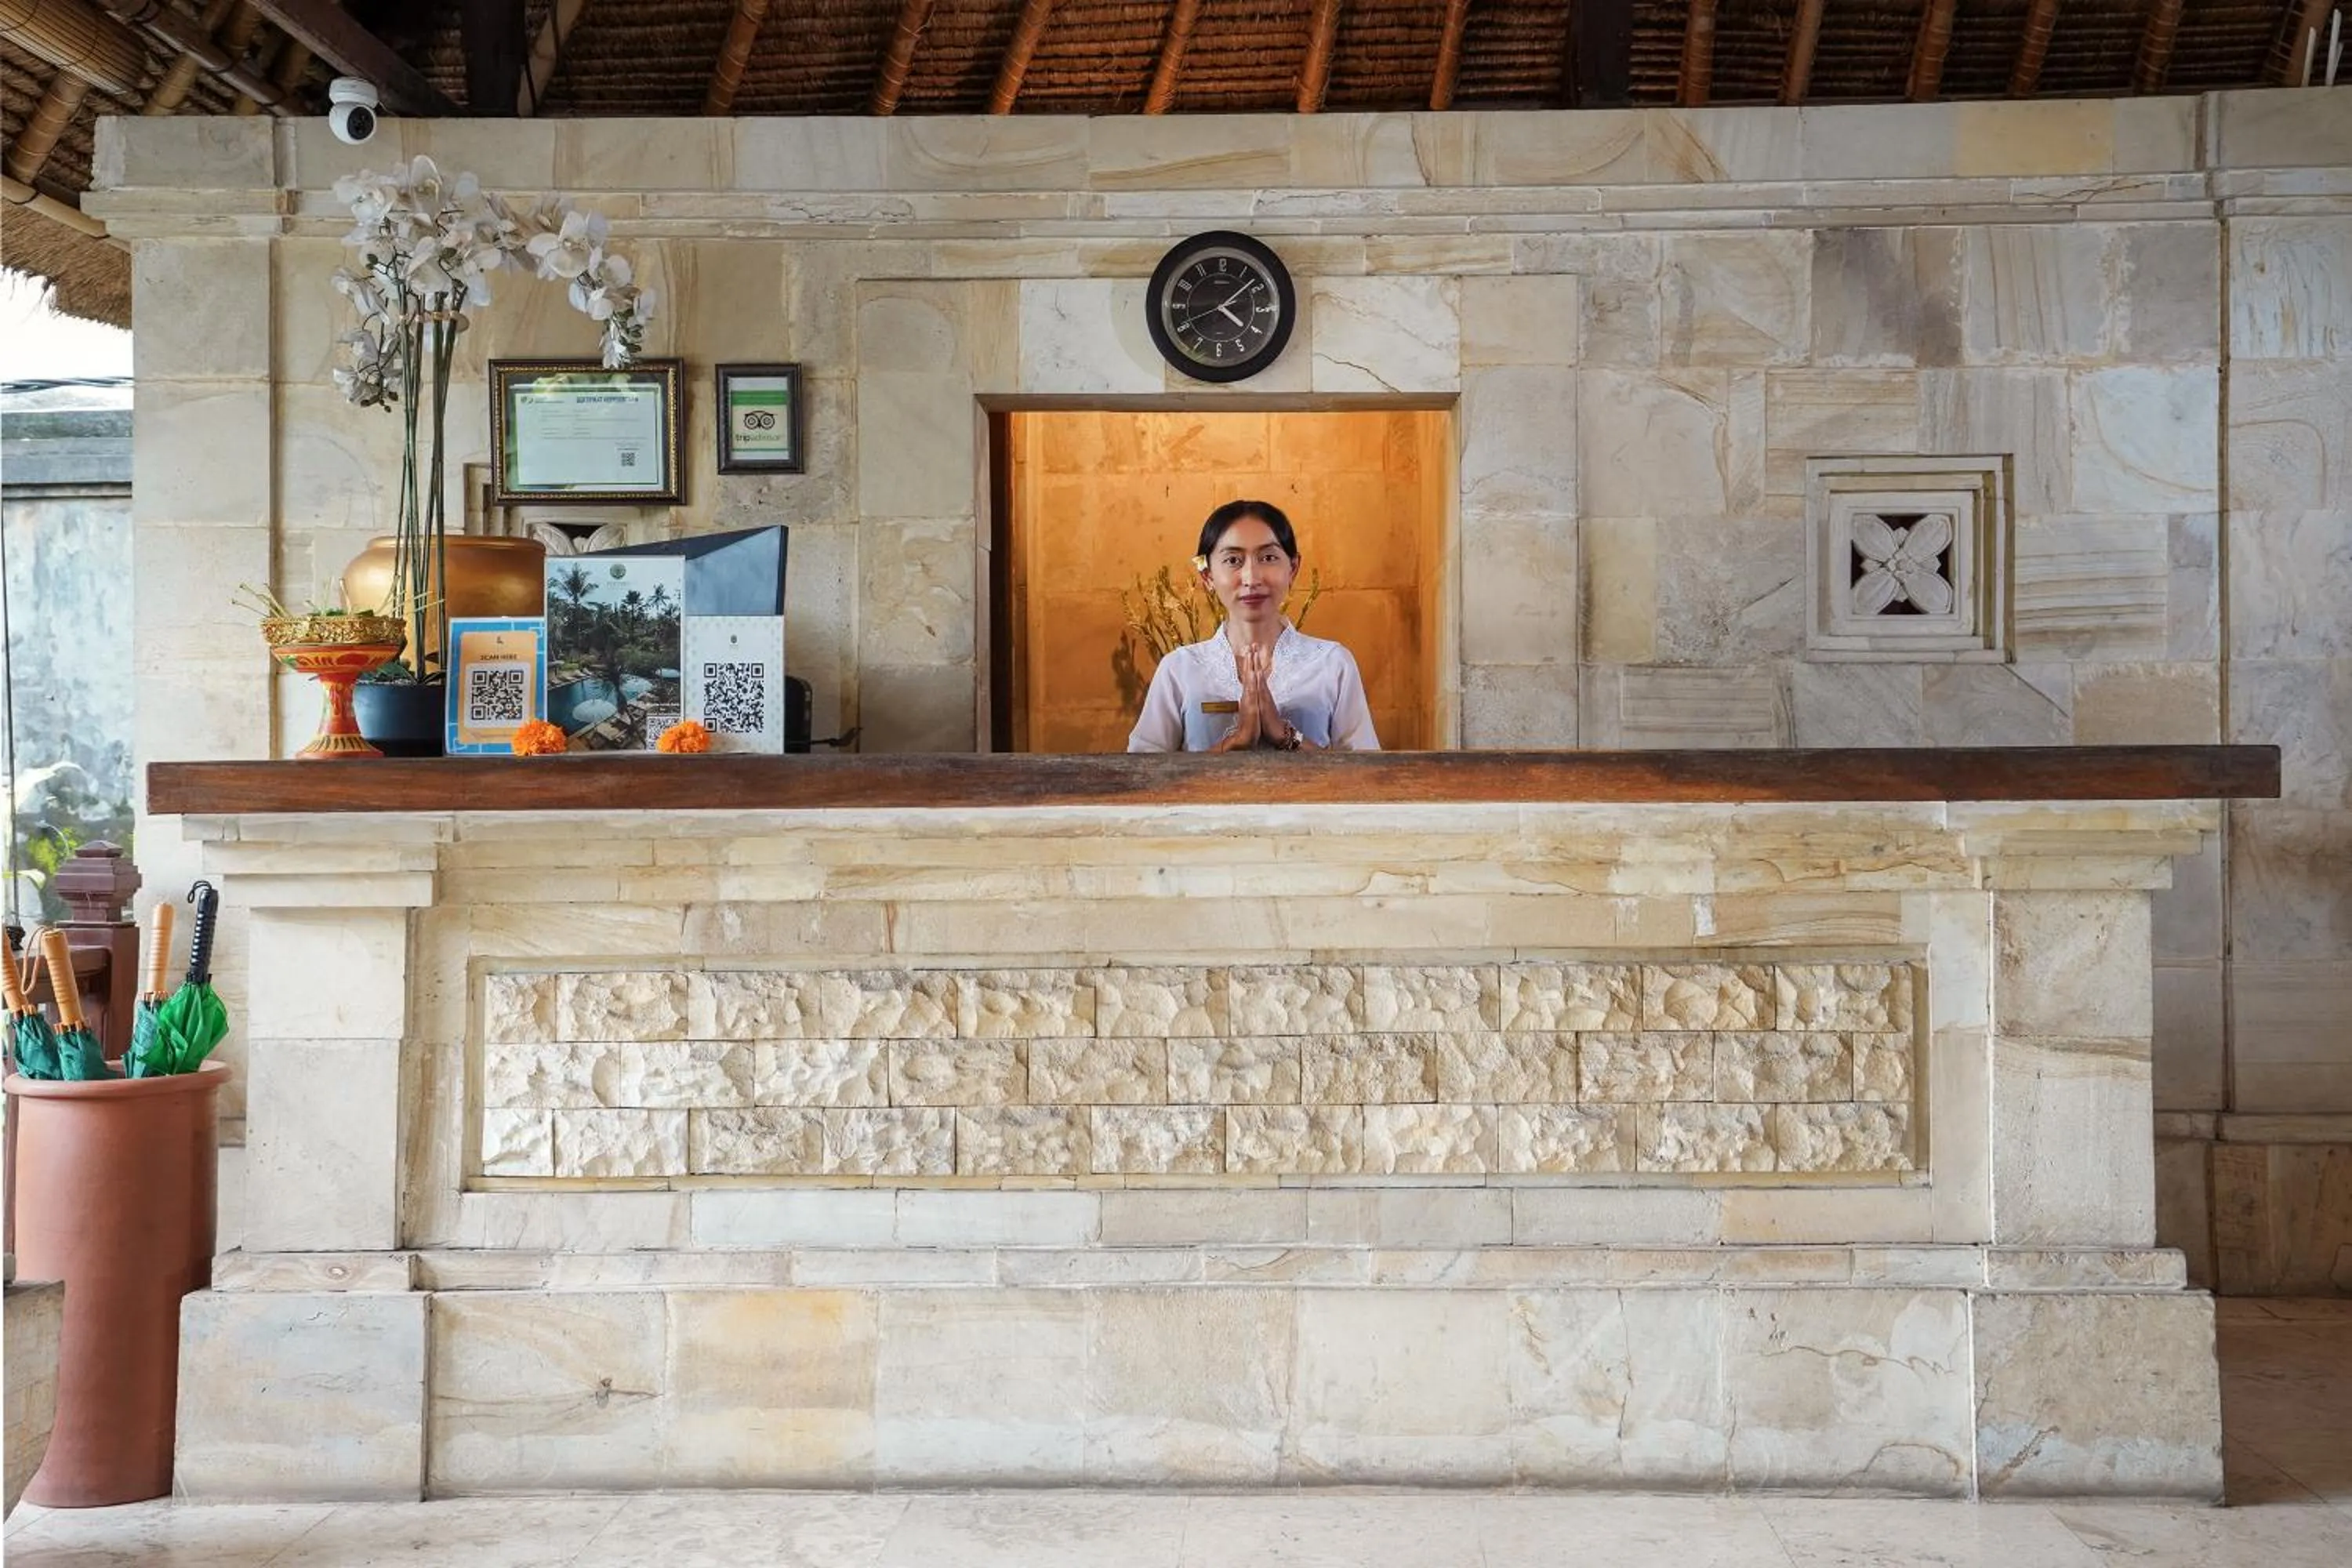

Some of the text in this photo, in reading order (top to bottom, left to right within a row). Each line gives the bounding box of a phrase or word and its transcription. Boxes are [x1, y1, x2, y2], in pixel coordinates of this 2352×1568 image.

[1195, 263, 1207, 277] 11
[1218, 258, 1228, 272] 12
[1240, 265, 1248, 278] 1
[1251, 283, 1265, 293] 2
[1250, 325, 1263, 335] 4
[1192, 336, 1203, 351] 7
[1216, 342, 1222, 357] 6
[1235, 338, 1245, 352] 5
